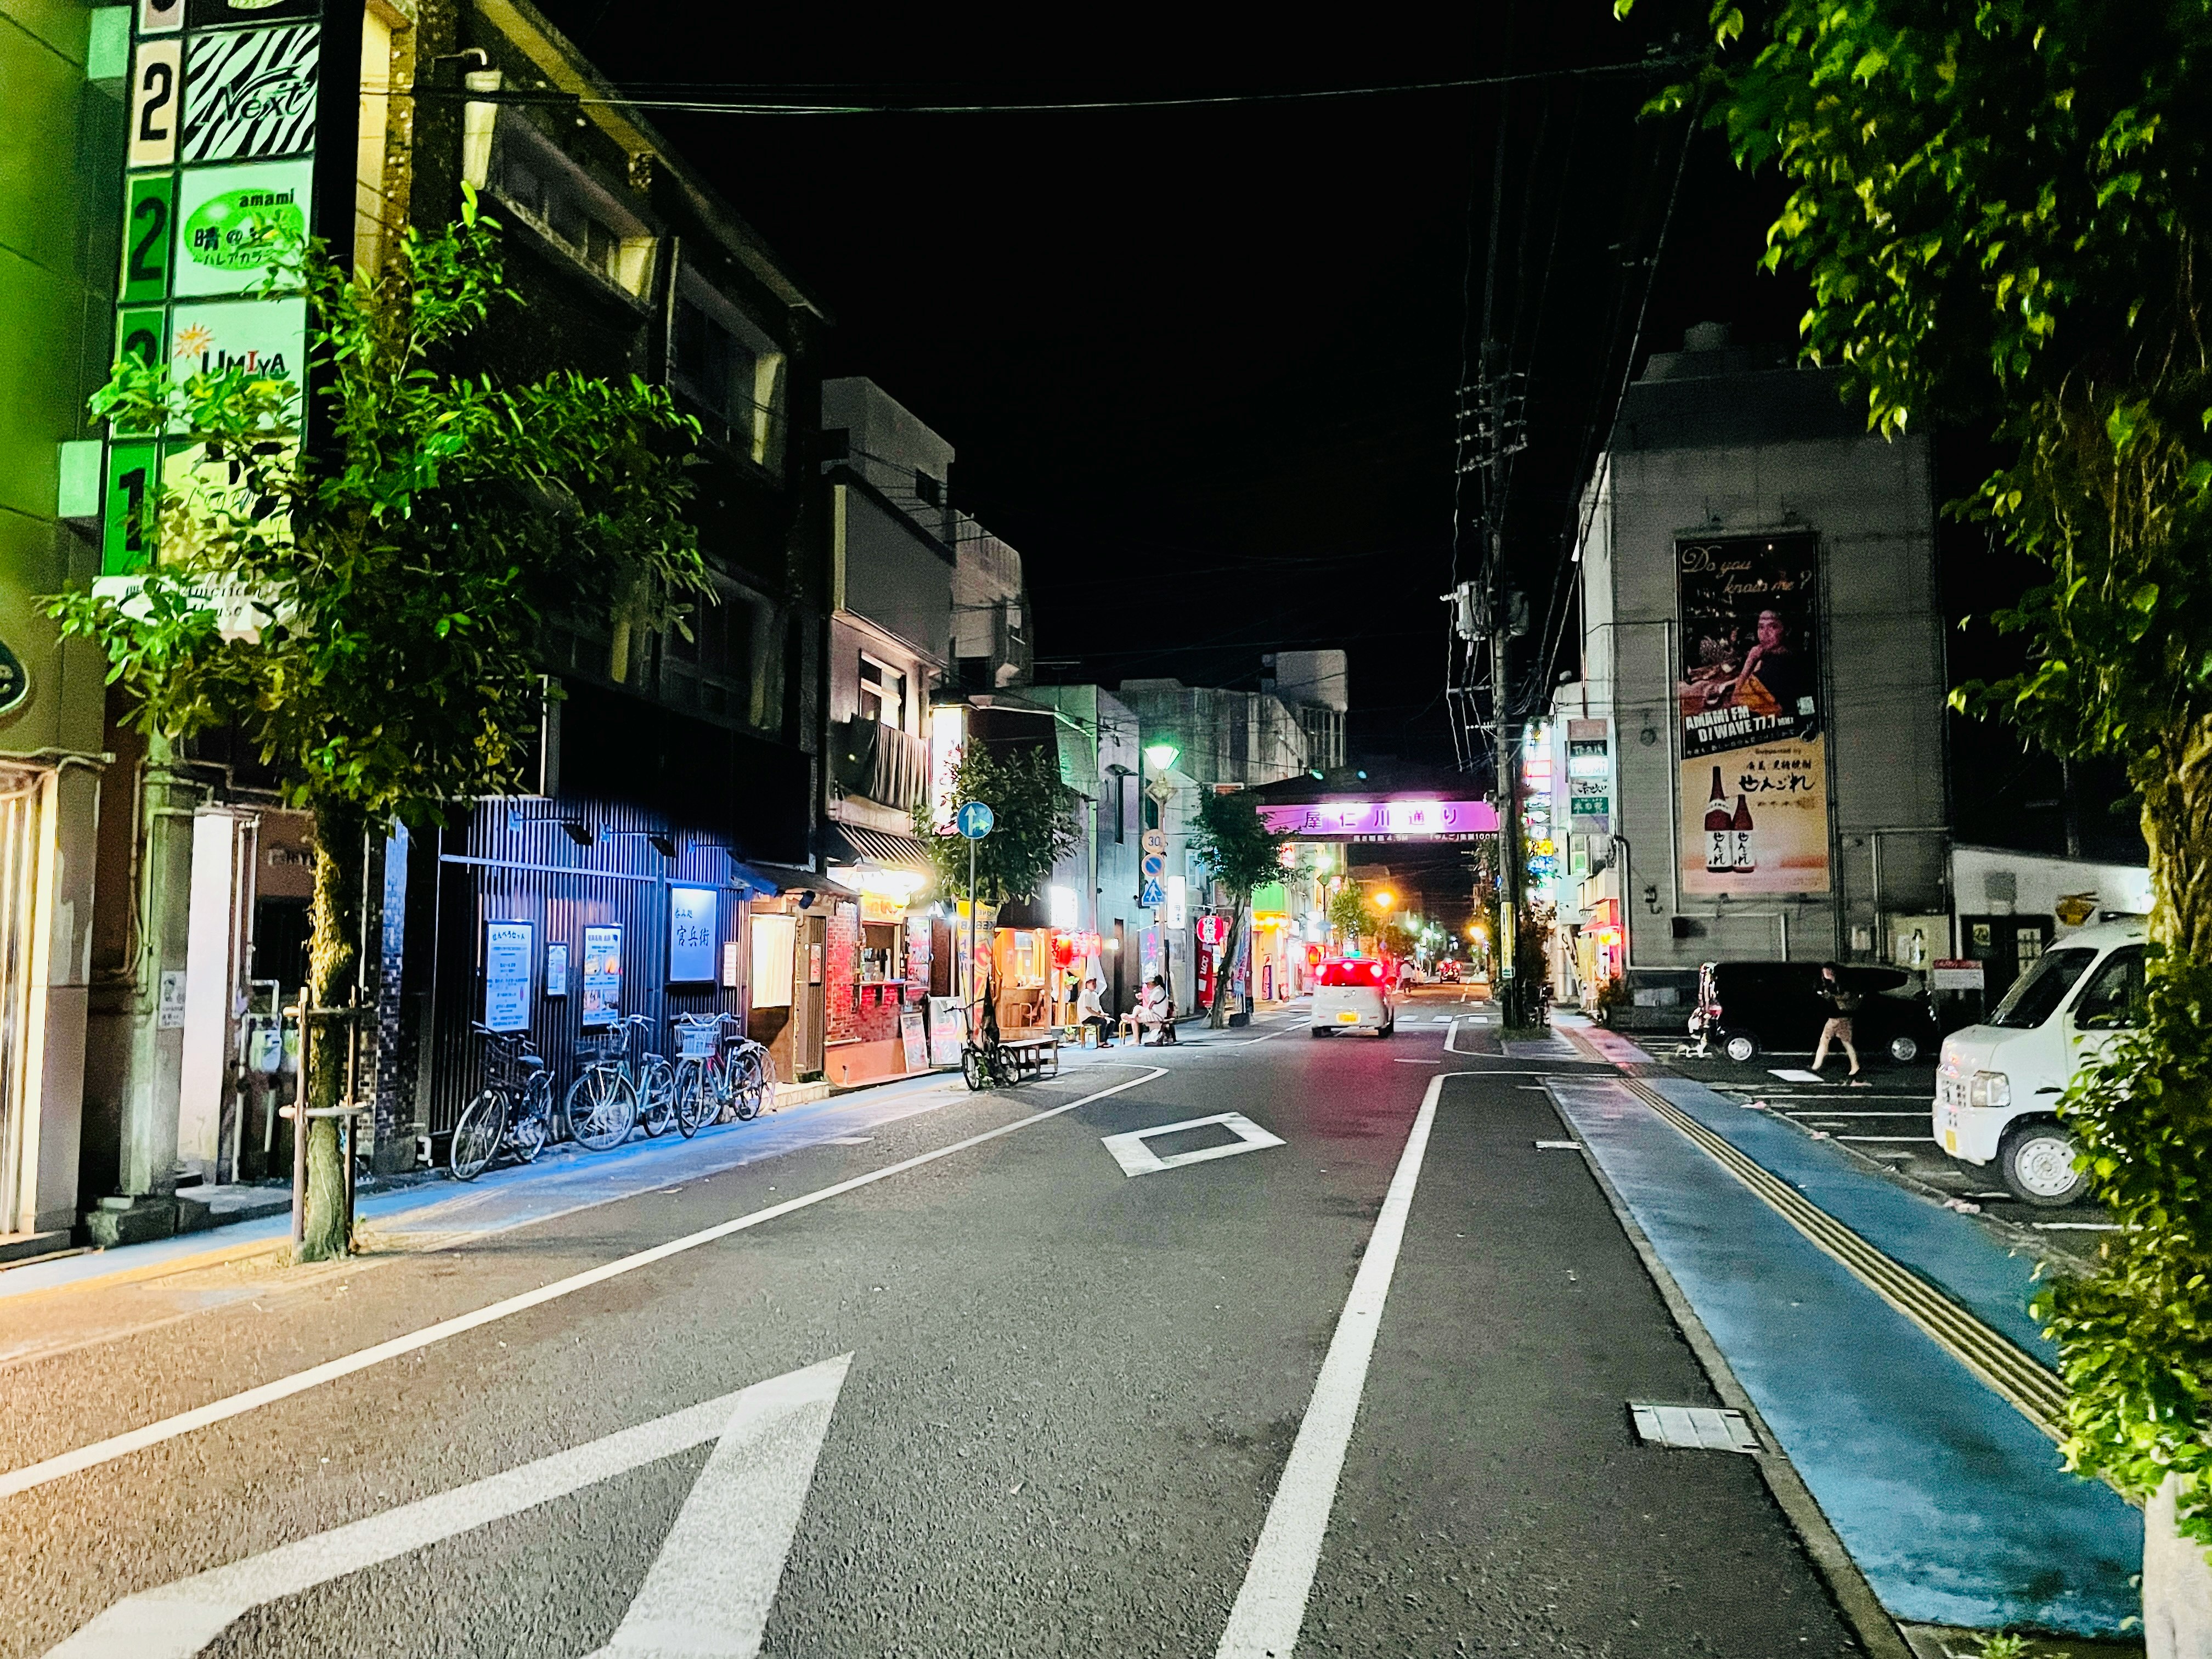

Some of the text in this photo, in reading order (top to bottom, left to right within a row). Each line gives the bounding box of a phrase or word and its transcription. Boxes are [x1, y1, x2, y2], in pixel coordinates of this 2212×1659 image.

[140, 63, 172, 140] 2
[194, 75, 310, 126] Next
[239, 188, 295, 207] amami
[131, 198, 166, 280] 2
[119, 468, 145, 551] 1
[1685, 705, 1750, 731] AMAMI FM
[1752, 714, 1775, 731] 77.7
[1305, 809, 1457, 827] 屋仁川通り
[1148, 836, 1161, 847] 30
